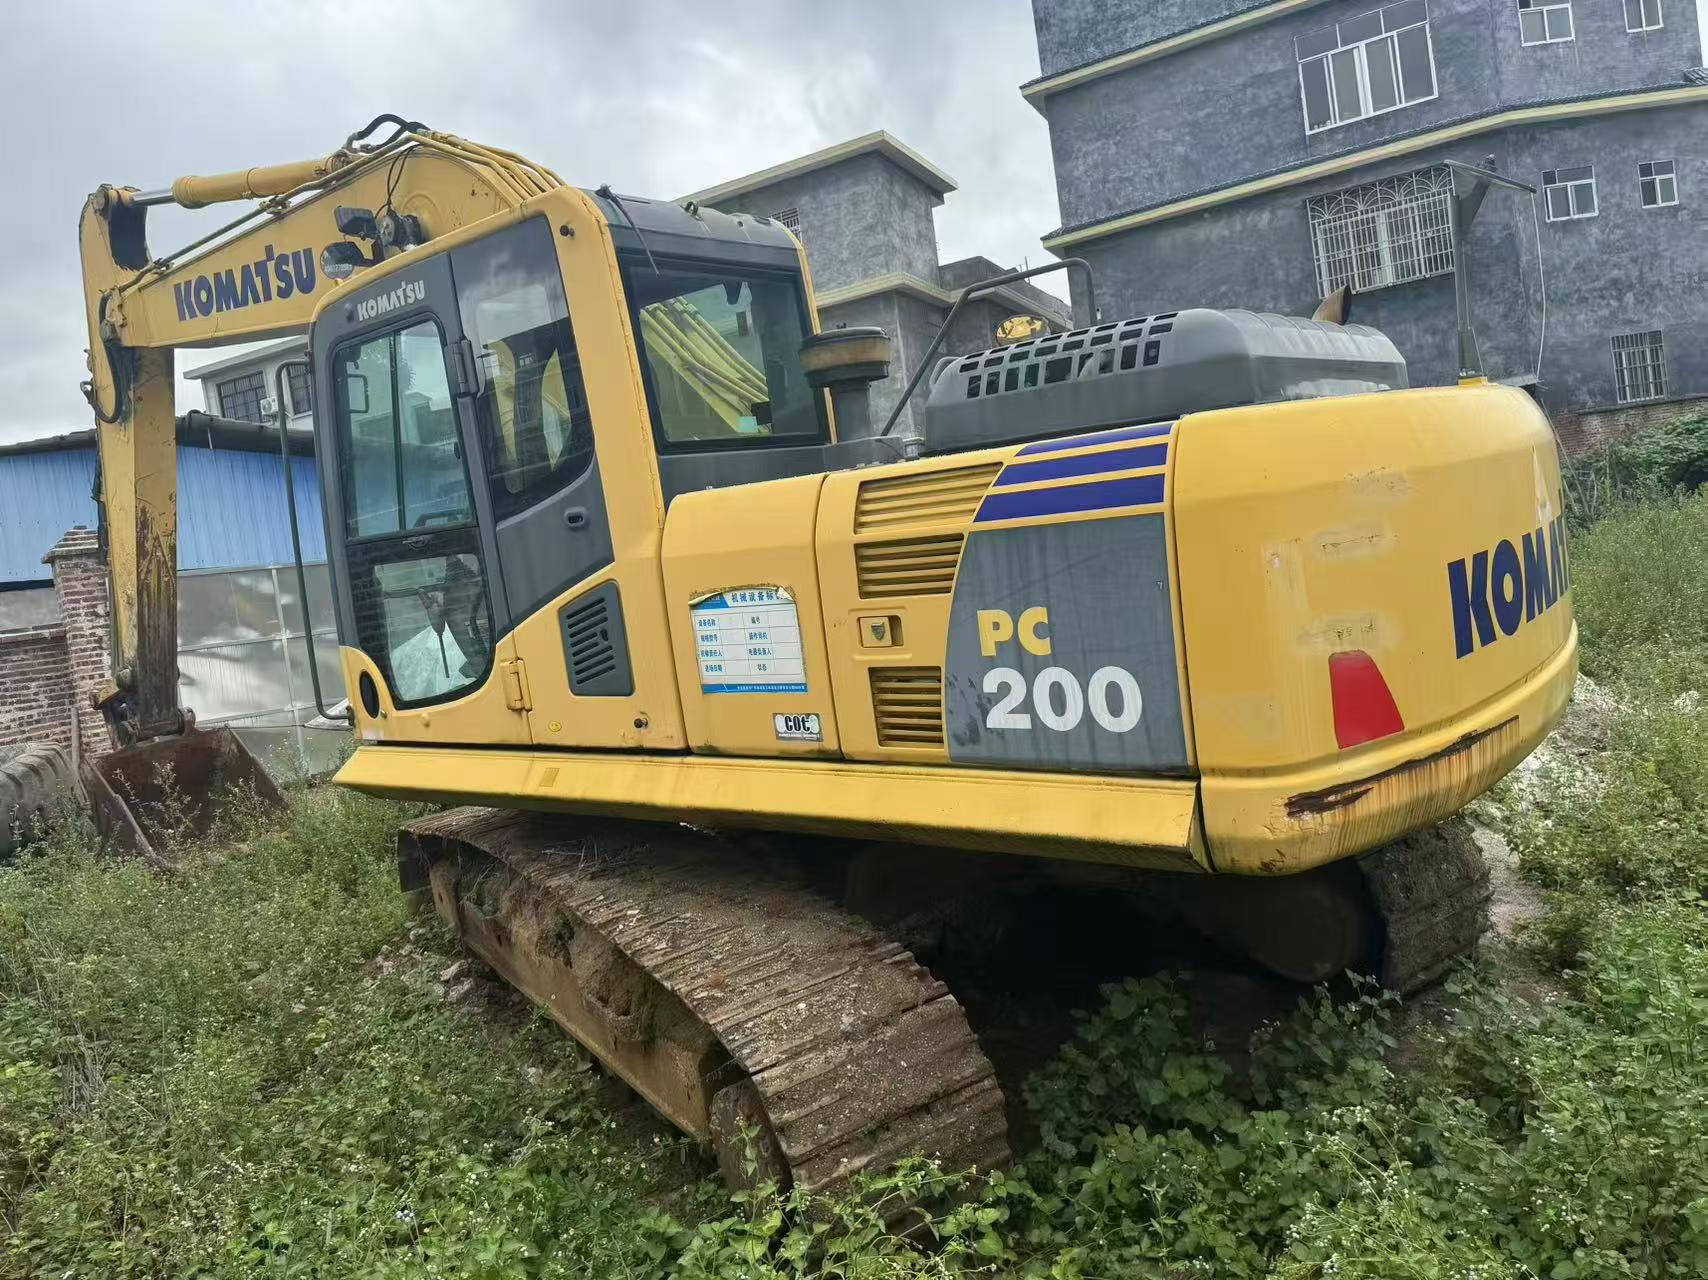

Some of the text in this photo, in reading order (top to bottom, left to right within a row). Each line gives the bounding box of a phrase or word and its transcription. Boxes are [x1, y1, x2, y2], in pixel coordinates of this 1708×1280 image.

[173, 244, 316, 322] KOMATSU
[357, 280, 425, 321] KOMATSU
[731, 590, 785, 603] 机械设备标
[977, 606, 1052, 657] PC
[982, 665, 1143, 733] 200
